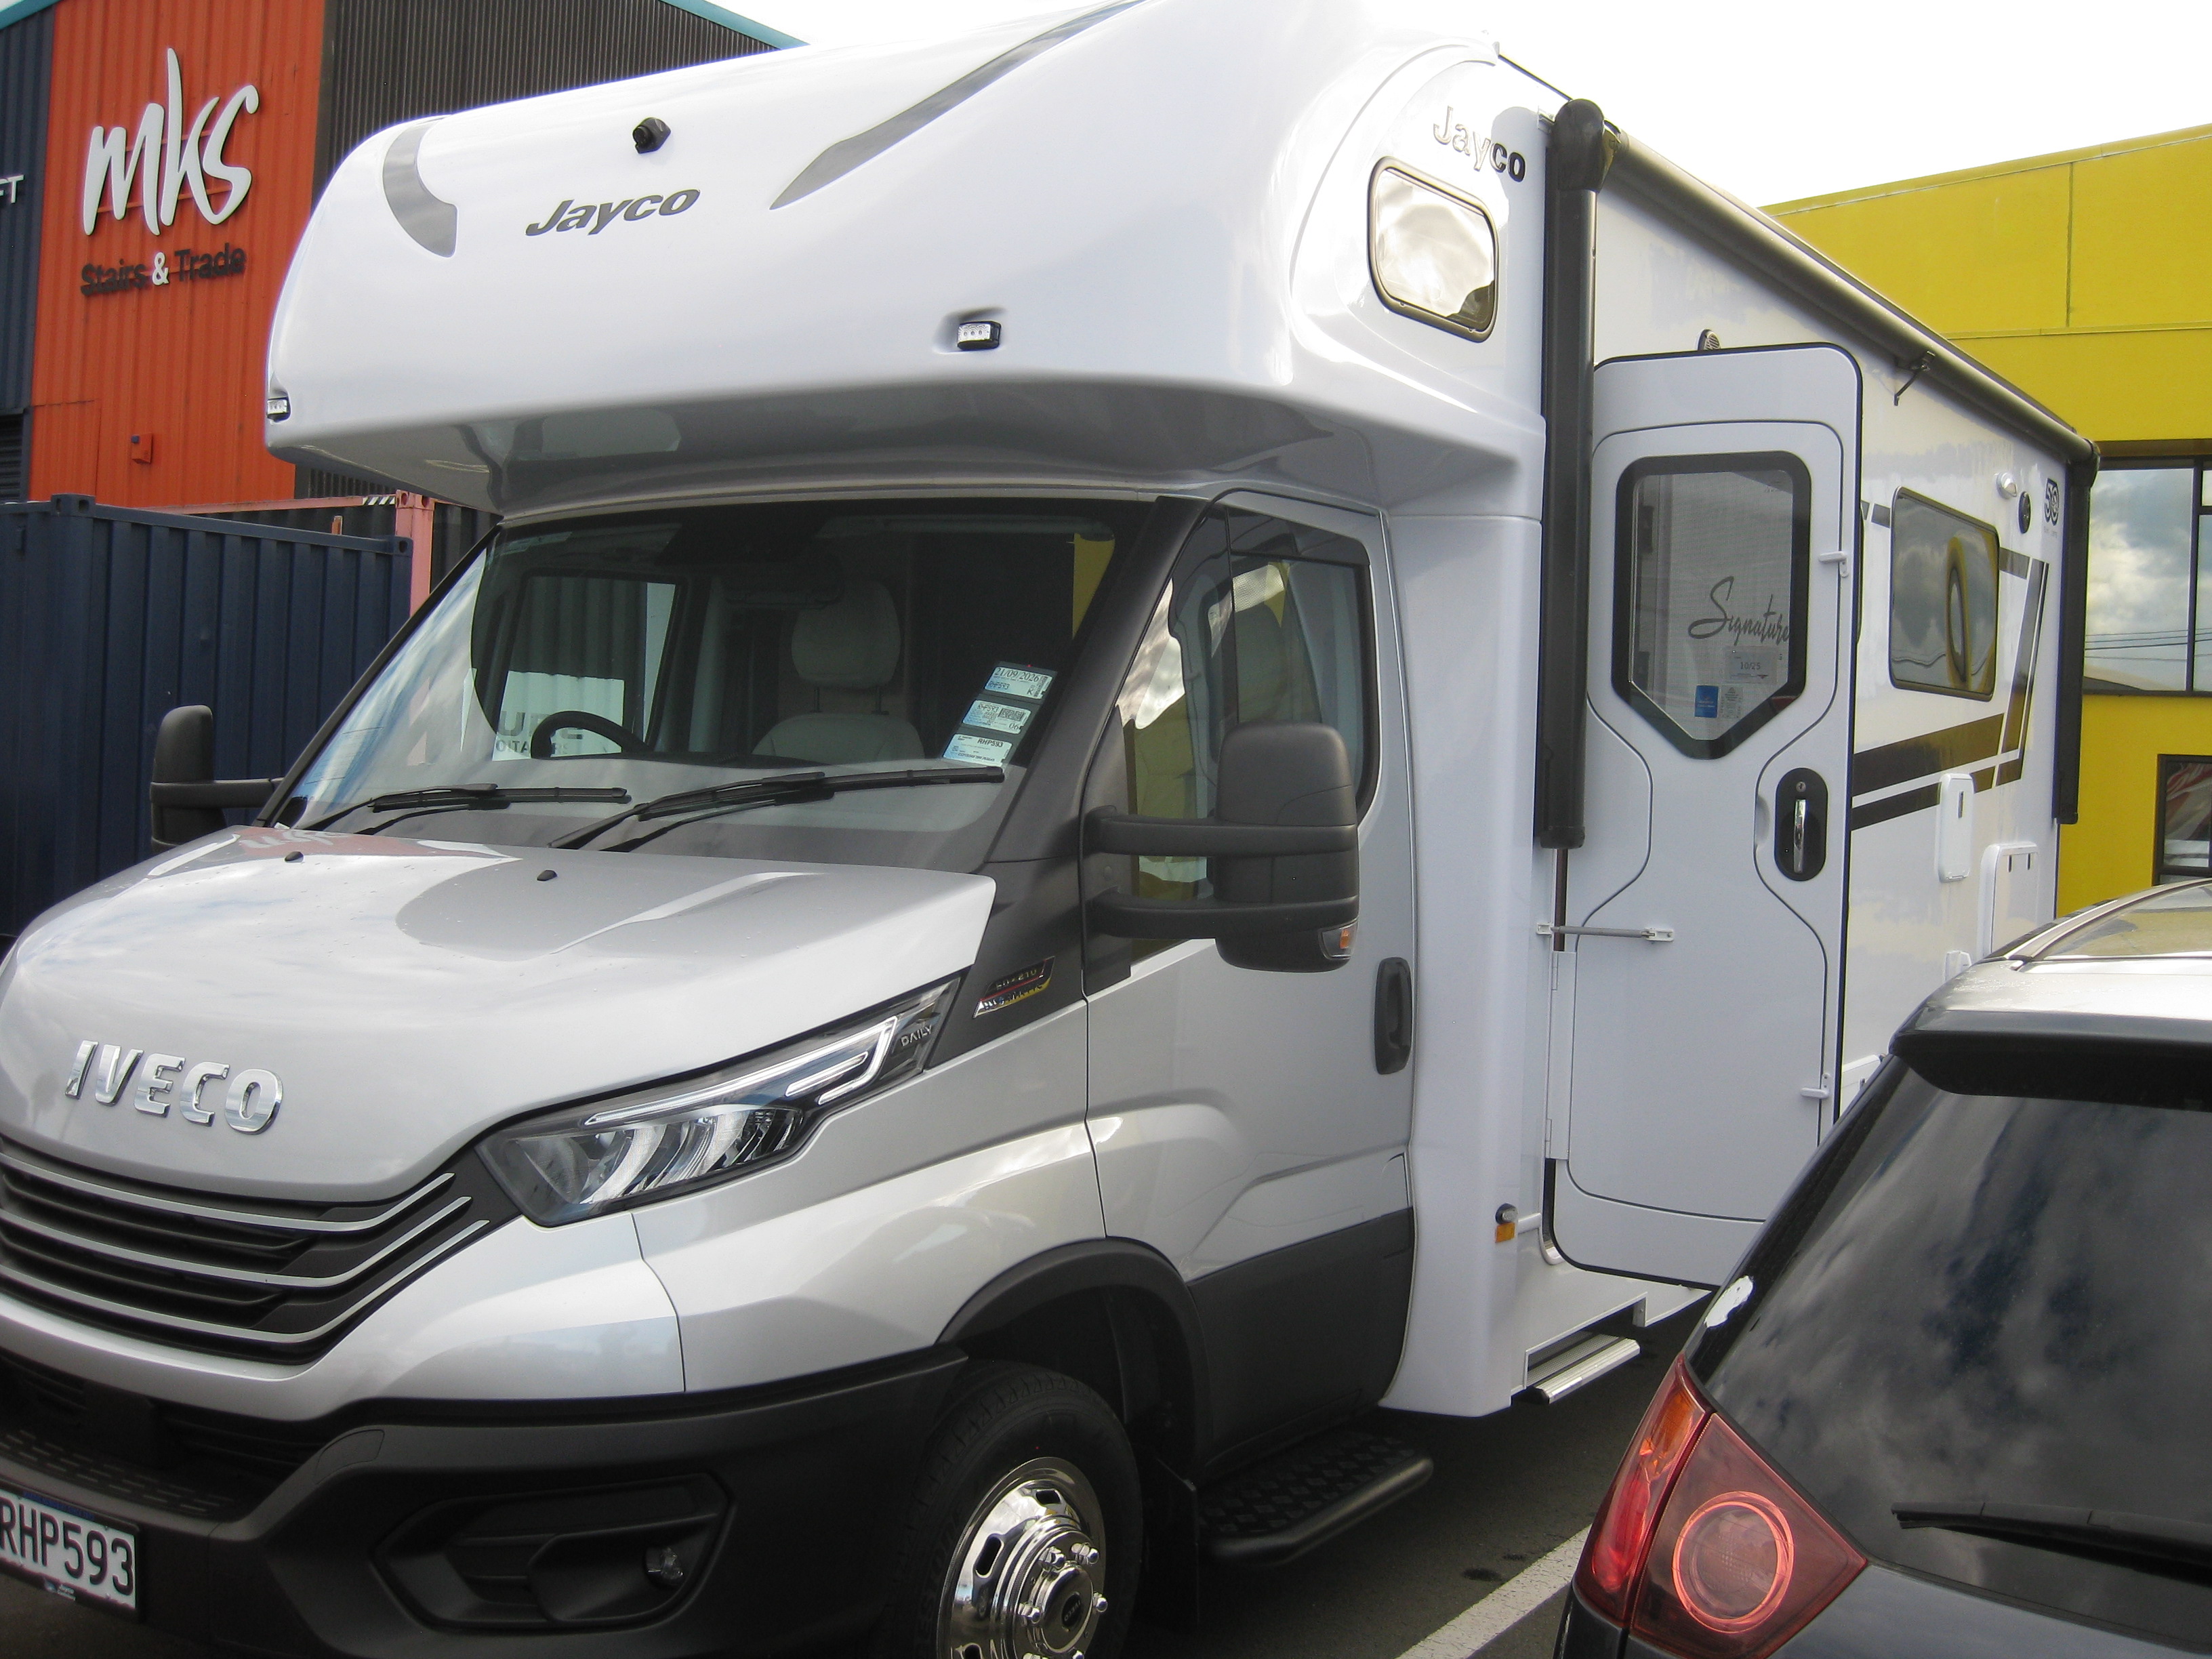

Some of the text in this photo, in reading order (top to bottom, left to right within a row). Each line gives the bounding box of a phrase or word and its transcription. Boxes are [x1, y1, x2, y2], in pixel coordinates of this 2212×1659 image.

[83, 48, 259, 236] mks
[1433, 105, 1526, 182] Jayco
[525, 188, 701, 236] Jayco
[81, 243, 246, 295] Stairs & Trade
[1687, 576, 1789, 646] Signature
[901, 1024, 932, 1046] DAILY
[64, 1040, 283, 1134] IVECO
[0, 1496, 134, 1596] RHP593
